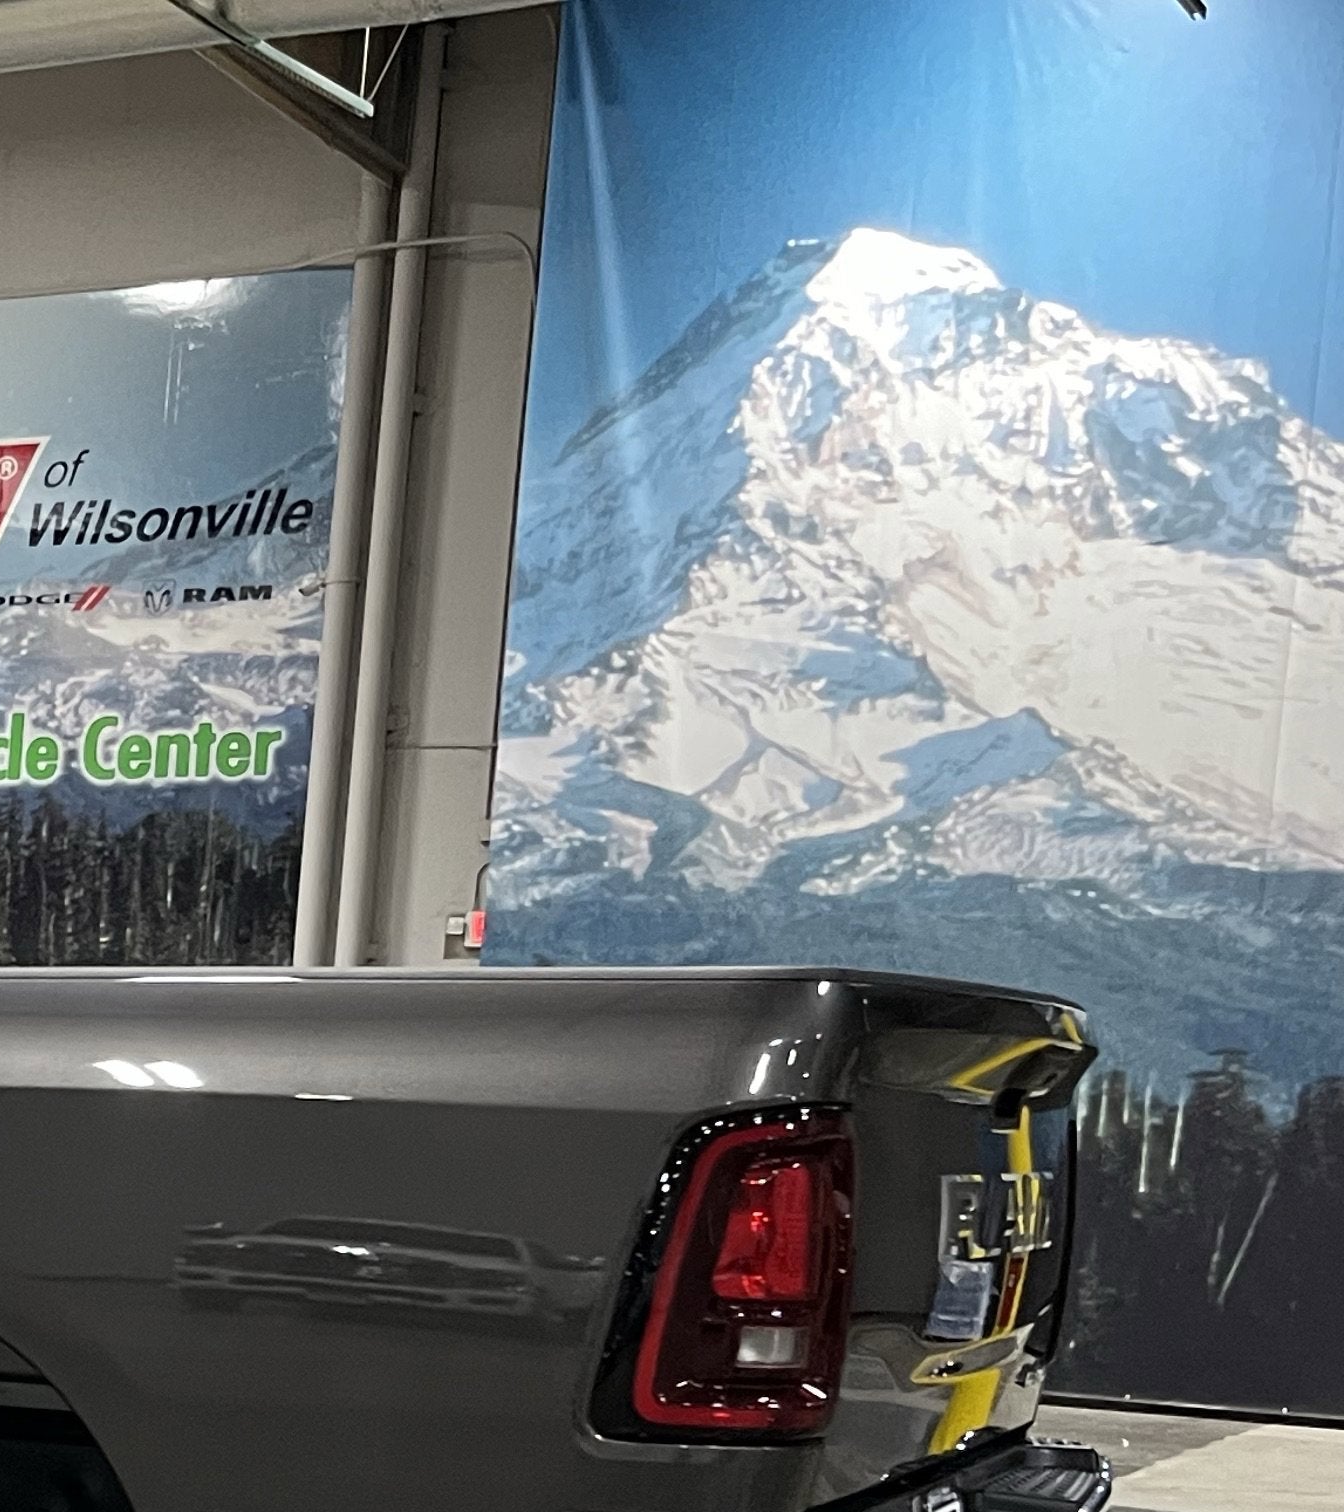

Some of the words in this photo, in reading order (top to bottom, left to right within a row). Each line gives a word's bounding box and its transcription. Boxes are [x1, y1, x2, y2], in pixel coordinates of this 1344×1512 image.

[43, 449, 90, 488] of
[28, 487, 313, 547] Wilsonville
[182, 585, 273, 605] RAM
[83, 715, 282, 780] Center
